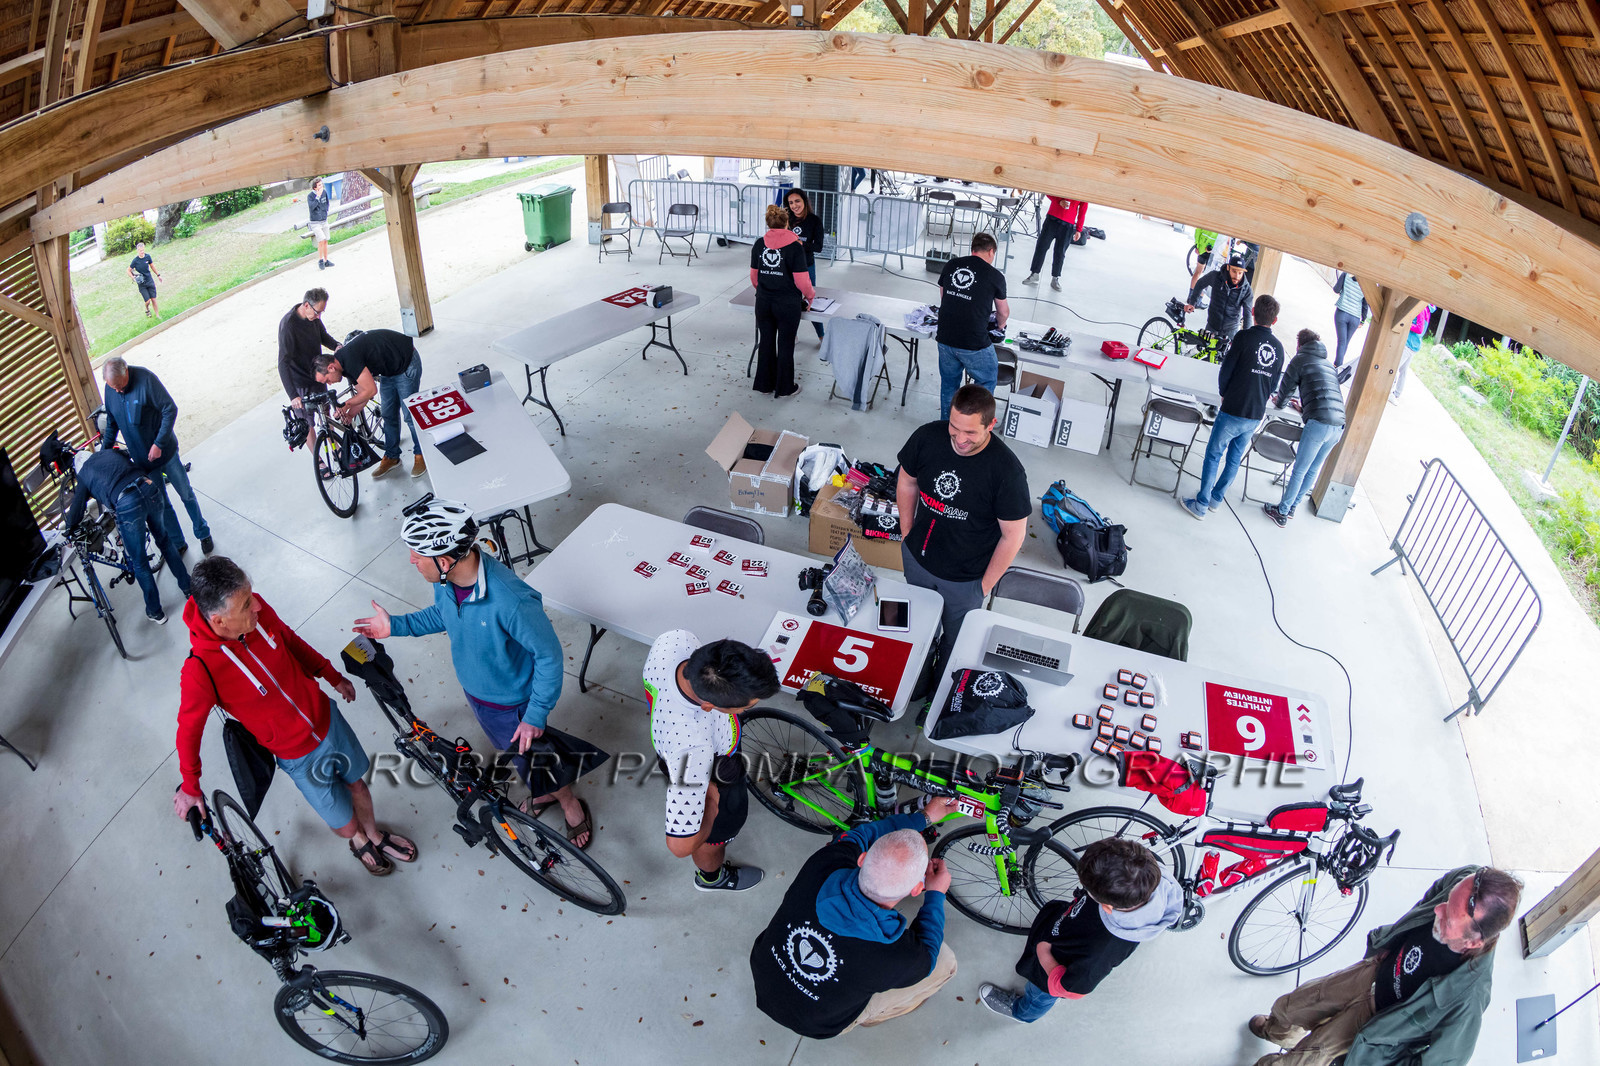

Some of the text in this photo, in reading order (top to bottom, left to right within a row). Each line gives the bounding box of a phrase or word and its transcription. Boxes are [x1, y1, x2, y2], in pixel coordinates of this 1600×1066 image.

[427, 396, 461, 420] 3B
[1006, 413, 1019, 438] Tacx
[1058, 420, 1071, 445] Tacx
[432, 534, 456, 547] KASK
[701, 536, 713, 544] 82
[679, 554, 691, 563] 51
[724, 553, 736, 562] 78
[697, 568, 710, 576] 35
[696, 581, 707, 589] 46
[728, 583, 740, 591] 13
[833, 635, 875, 673] 5
[1223, 690, 1273, 706] INTERVIEW
[1226, 698, 1271, 713] ATHLETES
[1235, 715, 1266, 752] 6
[959, 802, 973, 814] 17
[771, 945, 820, 1001] RACE ANGELS
